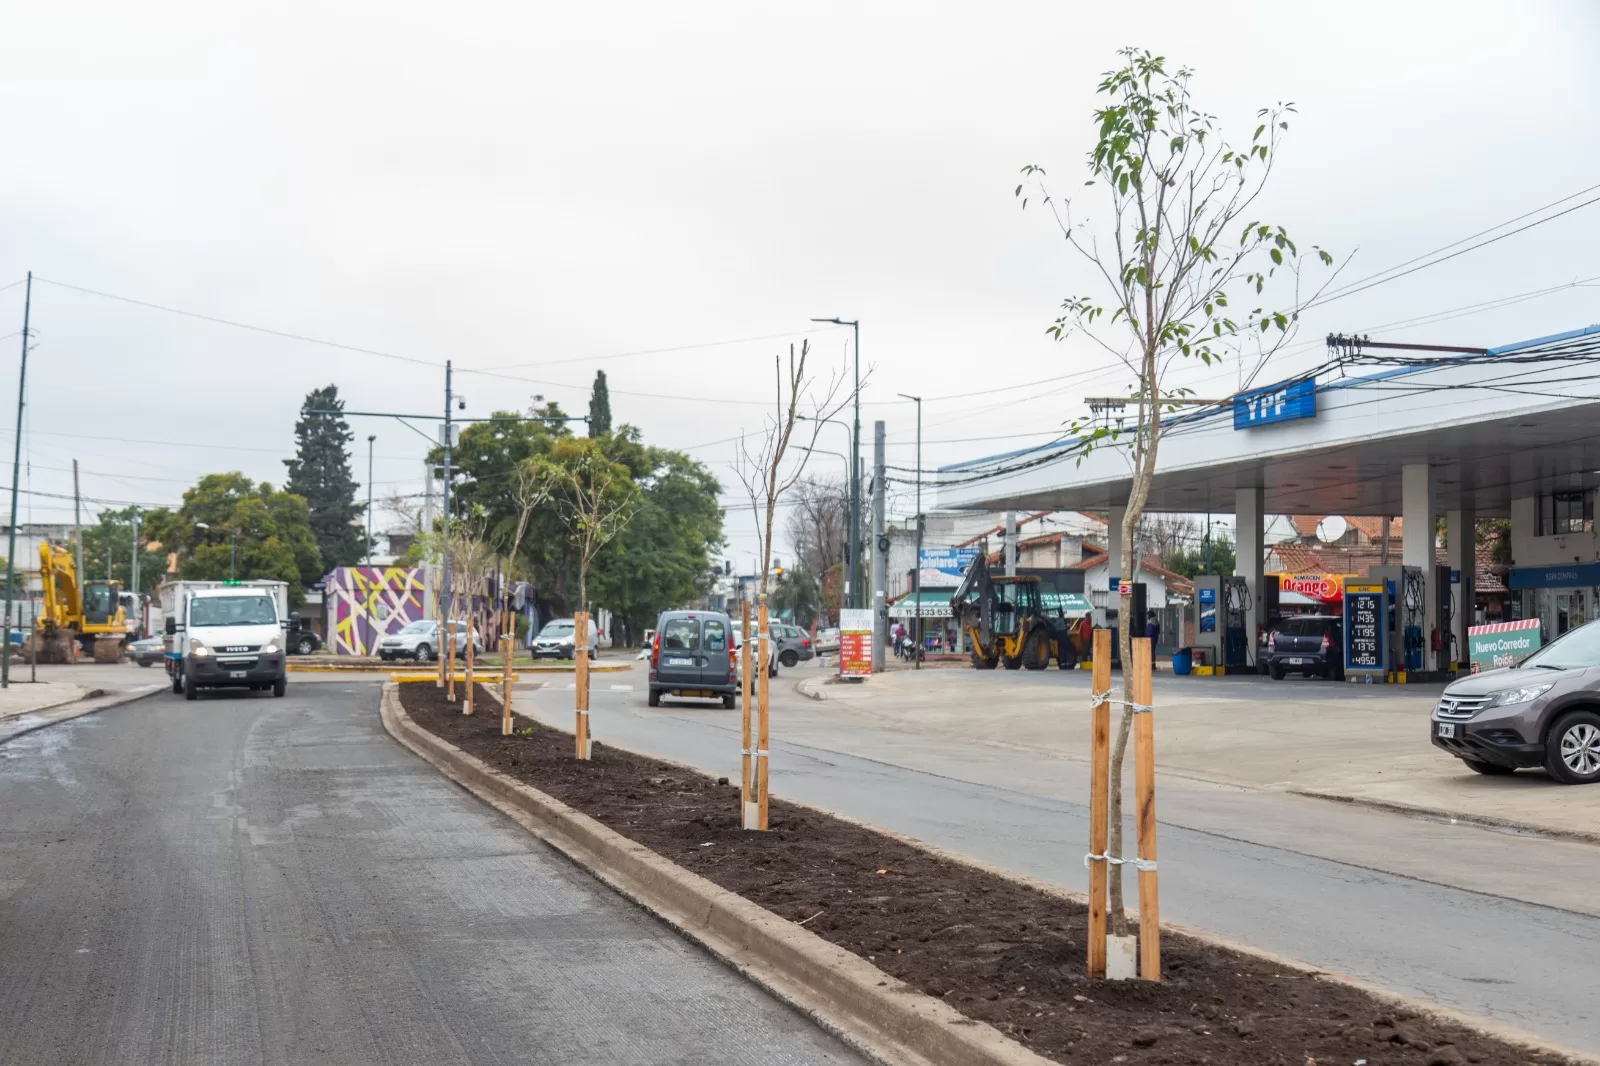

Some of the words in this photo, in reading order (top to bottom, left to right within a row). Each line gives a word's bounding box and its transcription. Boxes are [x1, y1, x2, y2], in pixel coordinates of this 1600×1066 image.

[1246, 390, 1287, 420] YPF
[1282, 578, 1328, 595] Orange
[1357, 614, 1375, 623] 1435
[1476, 642, 1497, 653] Nuevo
[1498, 637, 1530, 650] Corredor
[1493, 653, 1514, 667] Rolón
